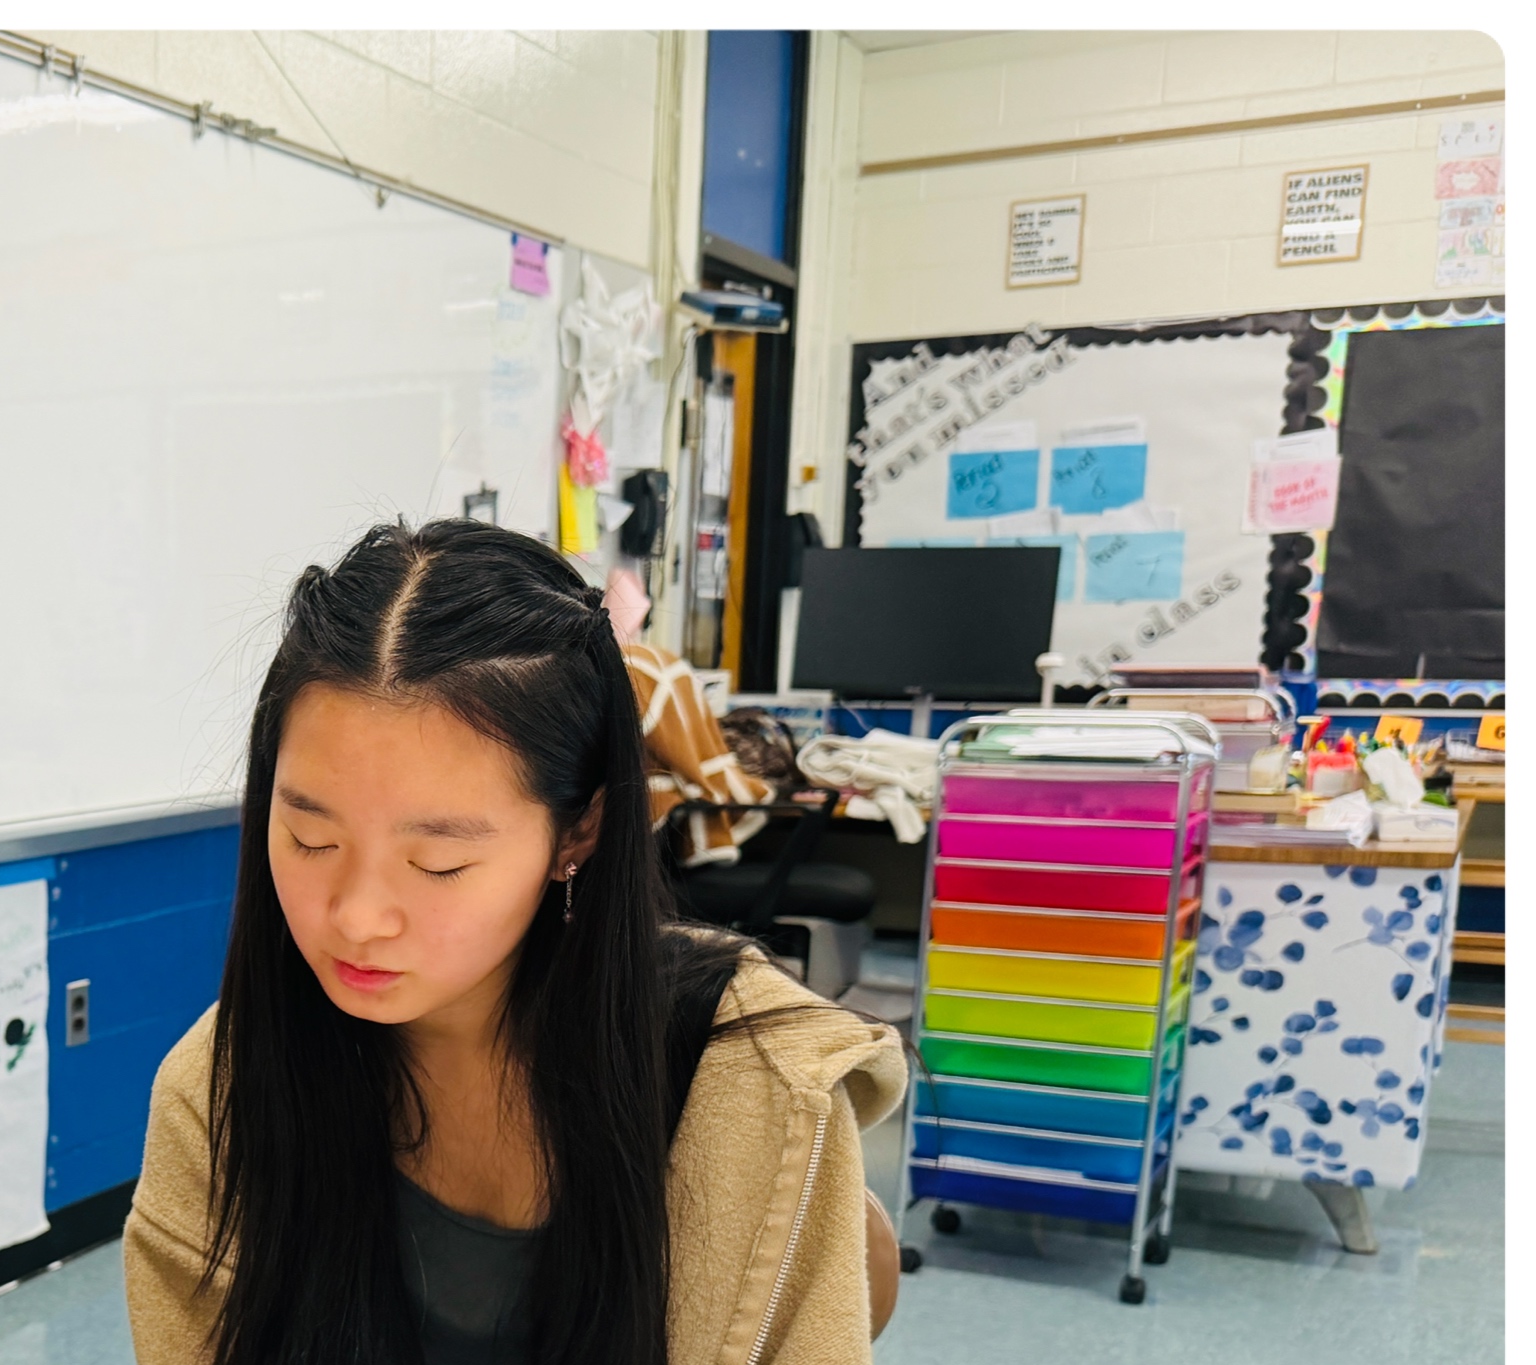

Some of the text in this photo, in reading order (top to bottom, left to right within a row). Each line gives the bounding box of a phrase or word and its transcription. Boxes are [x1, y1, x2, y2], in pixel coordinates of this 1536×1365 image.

[1287, 187, 1363, 203] CAN FIND
[1306, 173, 1363, 188] ALIENS
[1282, 243, 1337, 257] PENCIL
[863, 340, 934, 414] And
[854, 441, 929, 502] you
[1135, 570, 1241, 650] class
